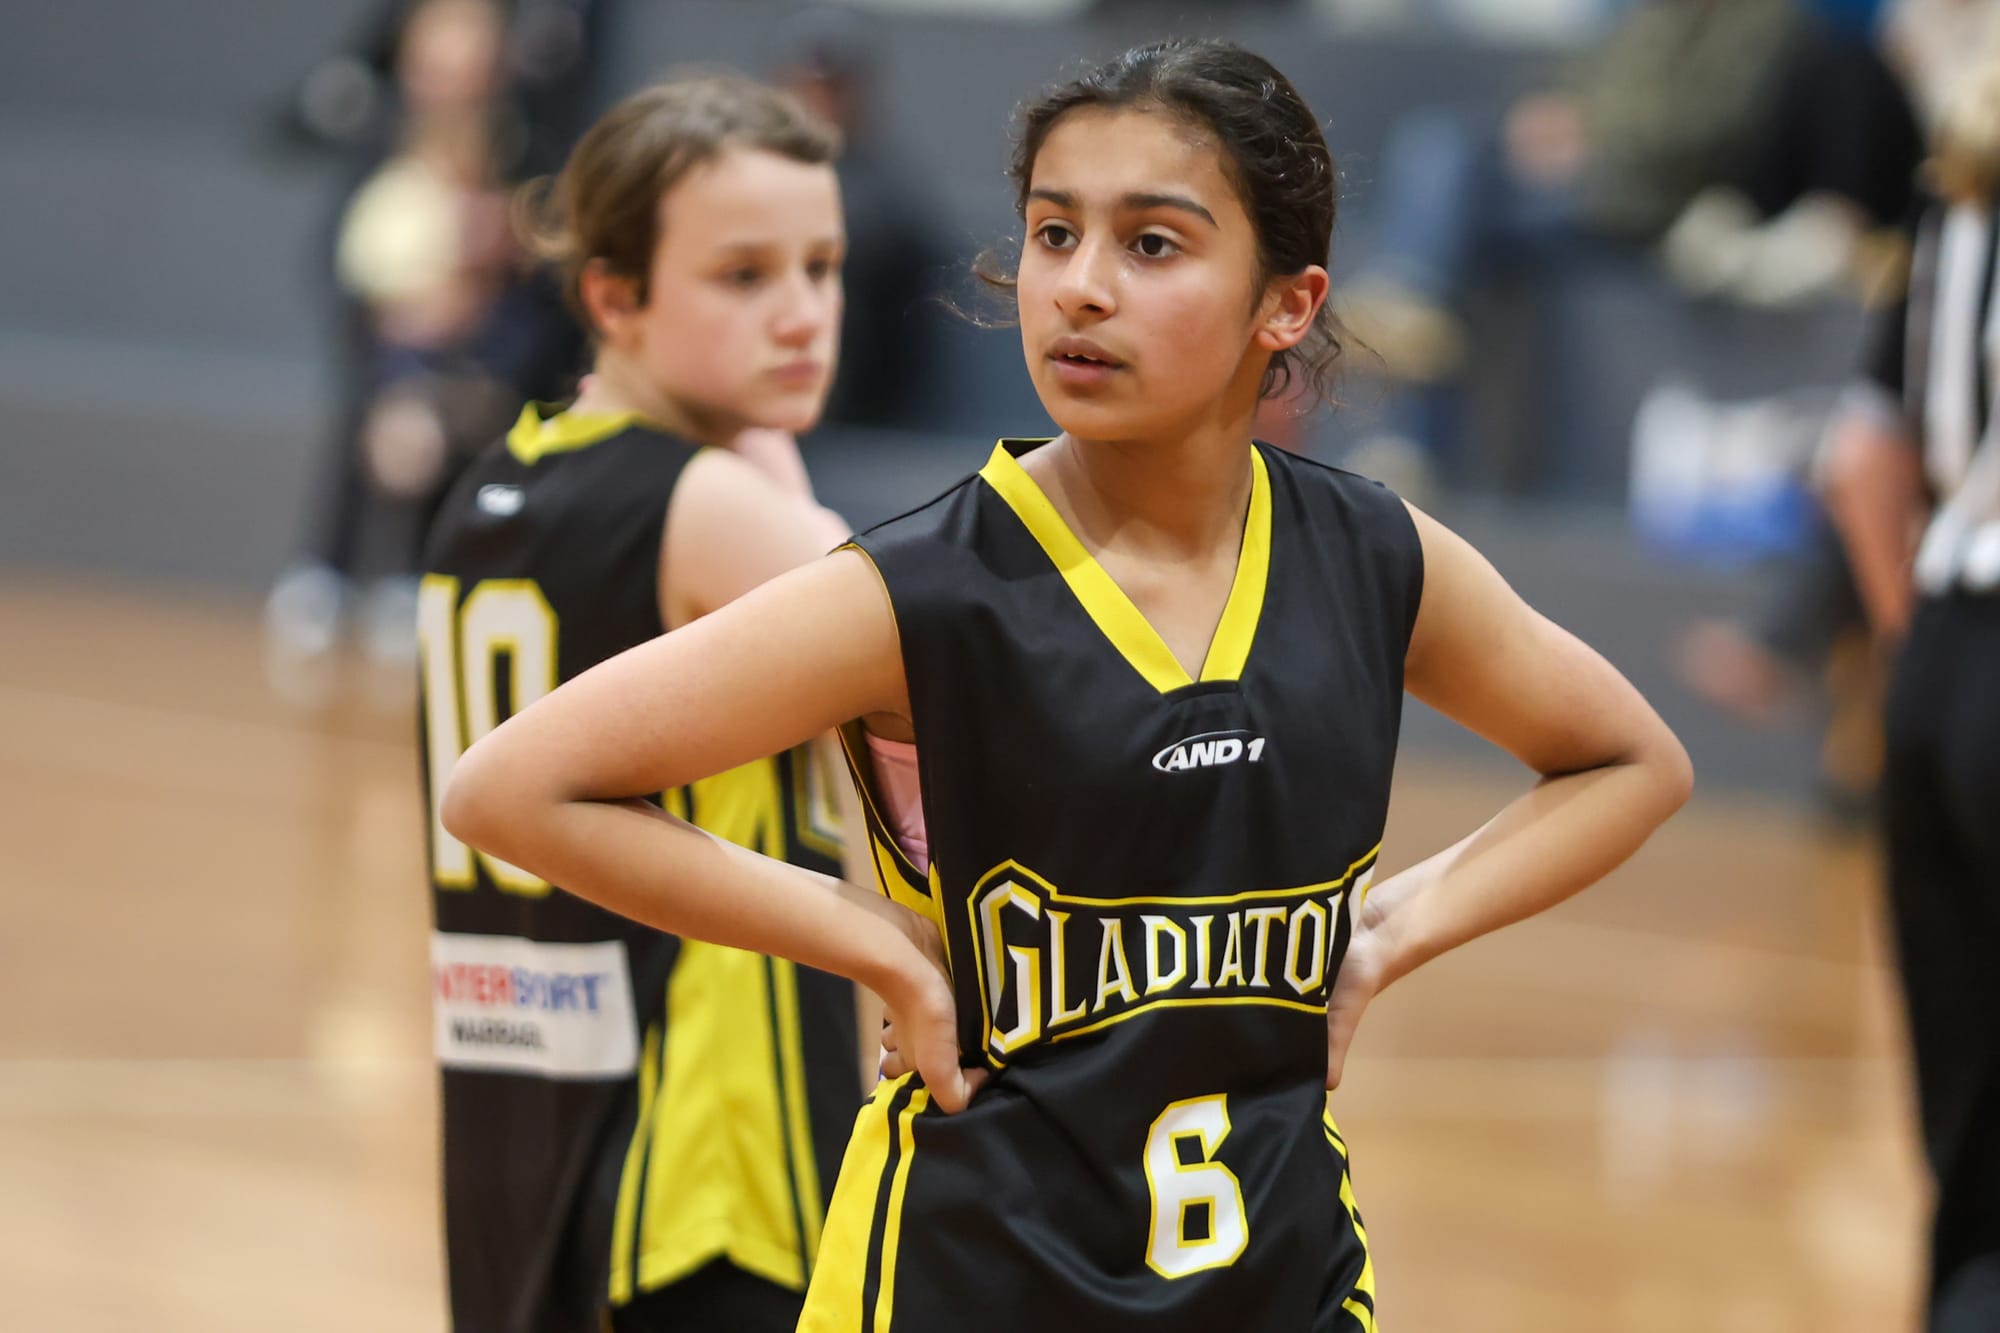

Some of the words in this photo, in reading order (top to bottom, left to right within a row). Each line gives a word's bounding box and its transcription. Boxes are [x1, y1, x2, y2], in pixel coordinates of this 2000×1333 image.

[418, 573, 559, 895] 10
[1164, 739, 1243, 771] AND
[1247, 738, 1265, 762] 1
[1143, 1093, 1249, 1279] 6
